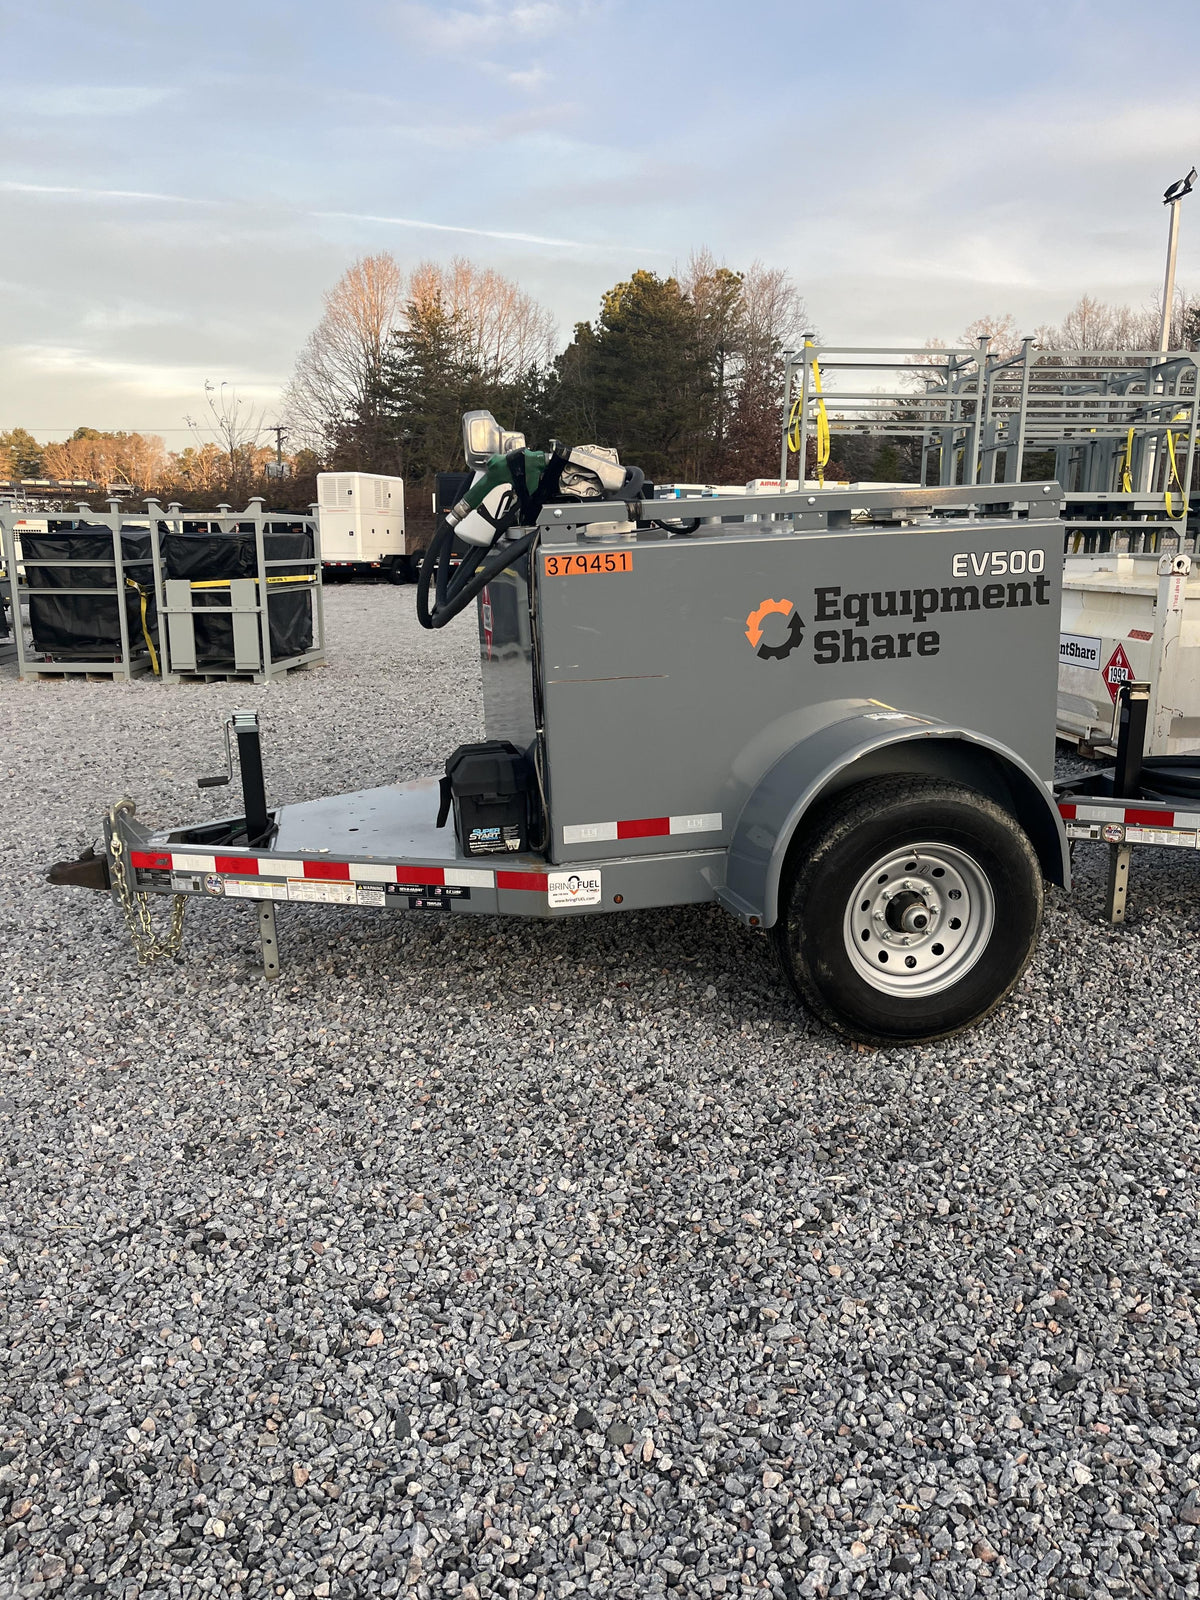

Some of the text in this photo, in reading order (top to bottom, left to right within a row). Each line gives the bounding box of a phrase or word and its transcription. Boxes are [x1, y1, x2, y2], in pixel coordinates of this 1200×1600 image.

[547, 553, 626, 575] 379451
[952, 549, 1045, 578] EV500
[814, 575, 1050, 627] Equipment
[814, 629, 940, 665] Share
[549, 882, 576, 891] BRING
[577, 880, 600, 889] FUEL
